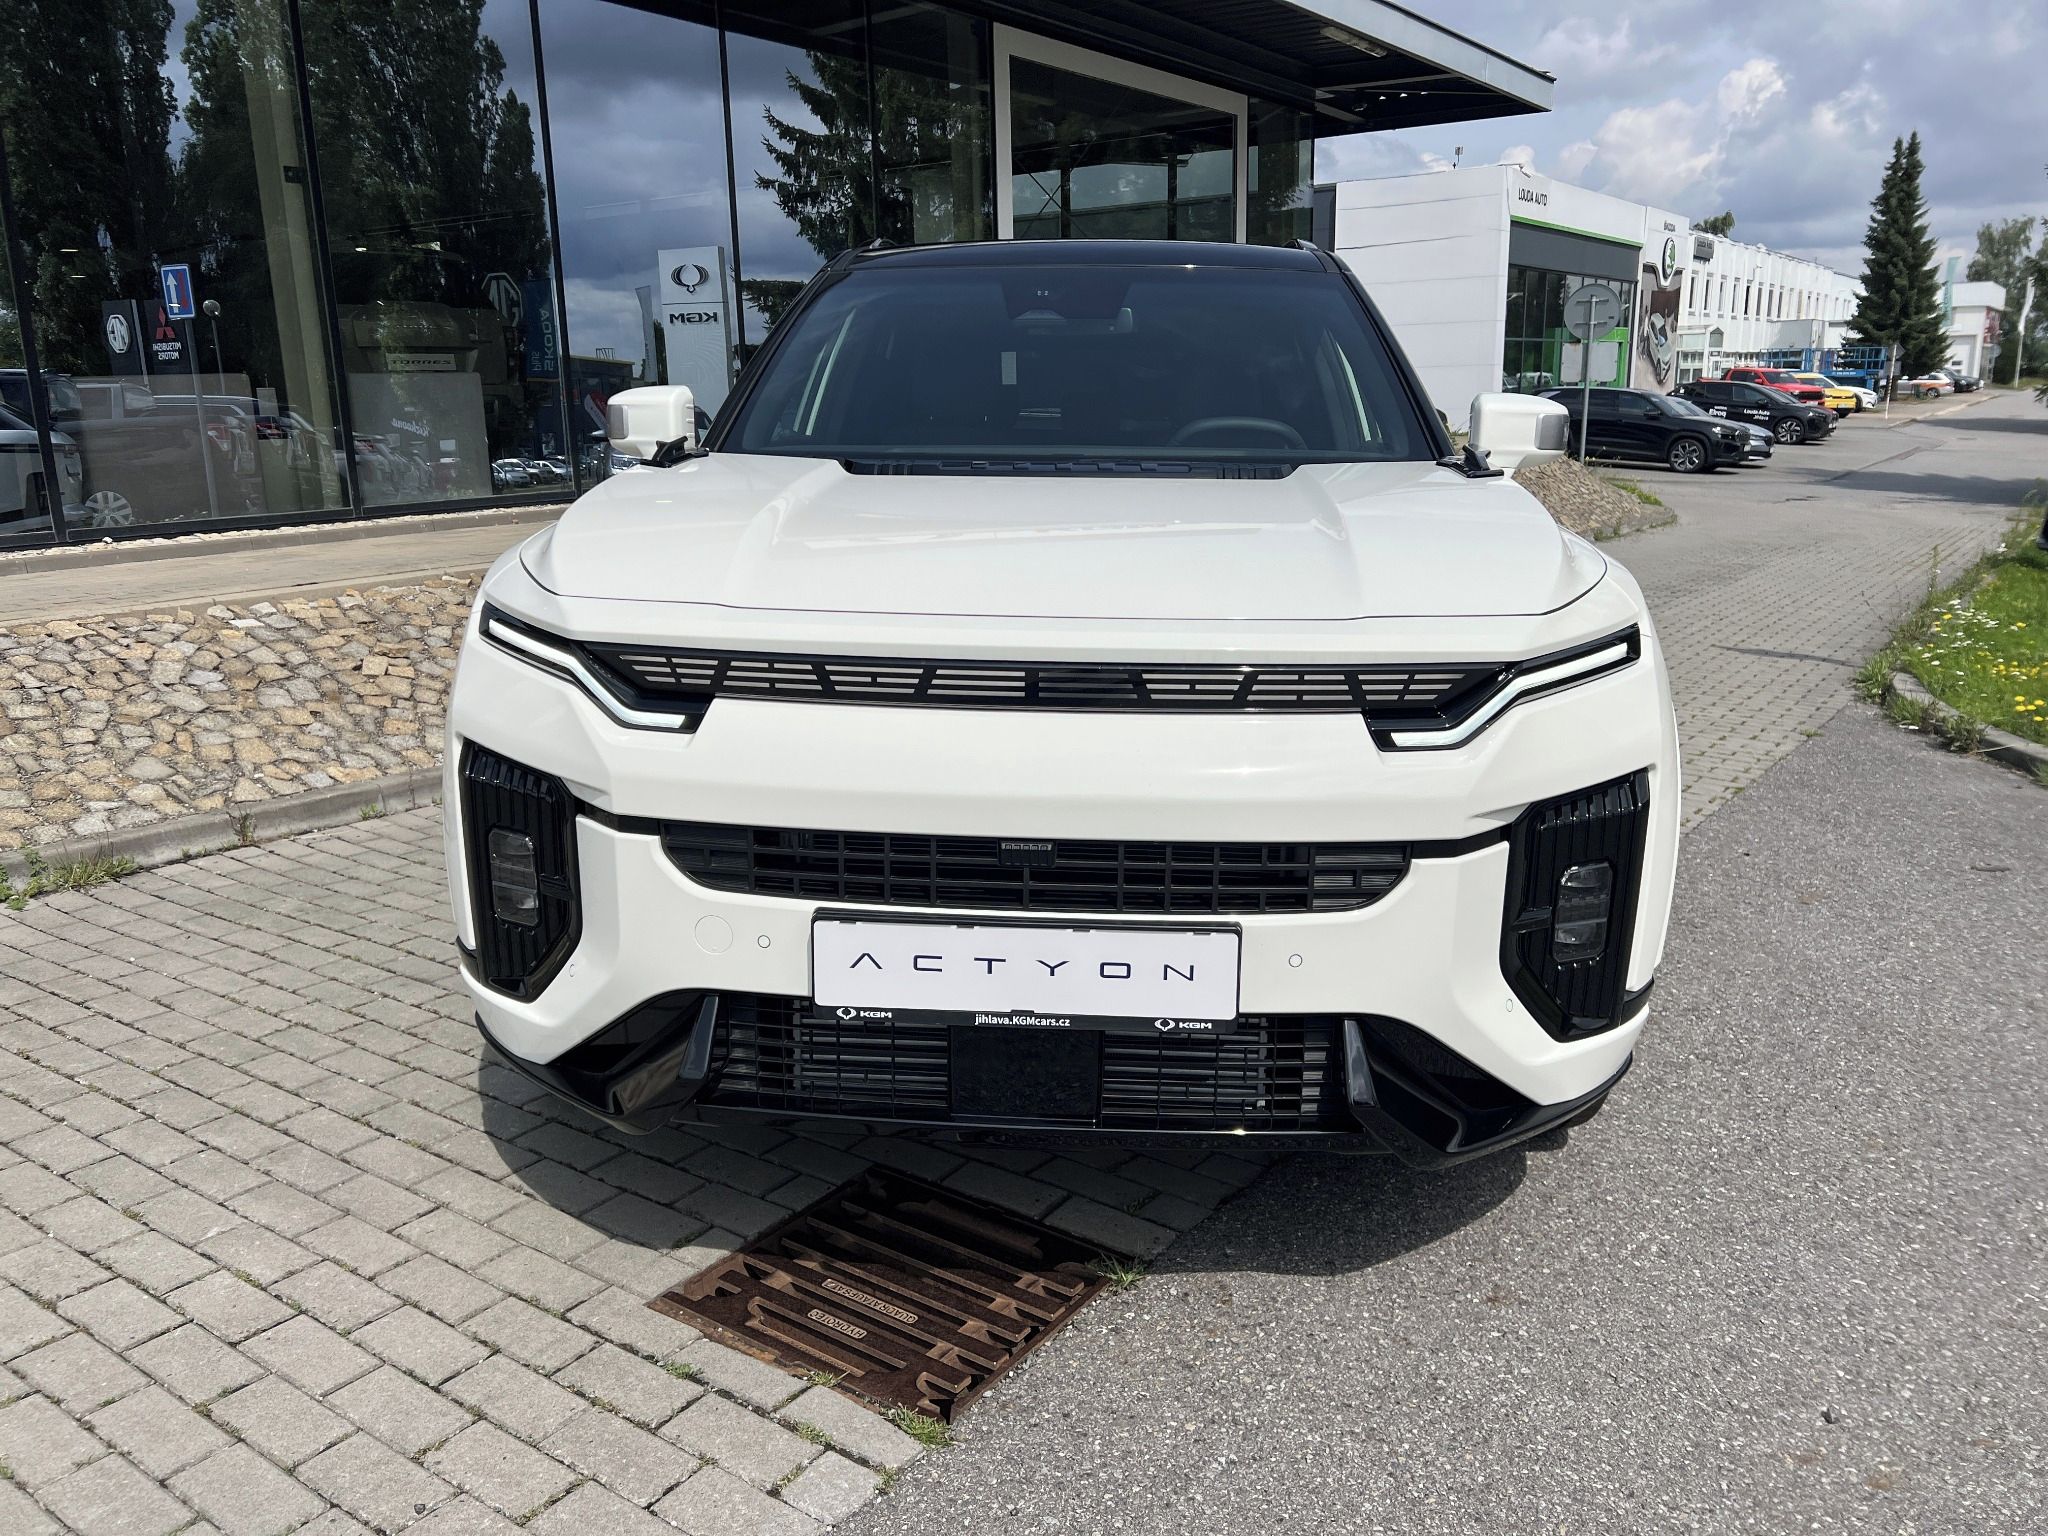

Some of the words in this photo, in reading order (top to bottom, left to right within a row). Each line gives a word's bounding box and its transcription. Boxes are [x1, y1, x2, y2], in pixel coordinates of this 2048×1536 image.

[1518, 187, 1533, 203] LOUDA
[1535, 192, 1548, 206] AUTO
[1709, 408, 1726, 418] Elroq
[849, 953, 1195, 983] ACTYON
[860, 1010, 893, 1018] KGM
[974, 1014, 1071, 1027] jihlava.KGMcars.cz
[1178, 1021, 1213, 1029] KGM
[825, 1280, 917, 1323] QUADRATAUFSATZ
[809, 1310, 866, 1338] HYDROTEC
